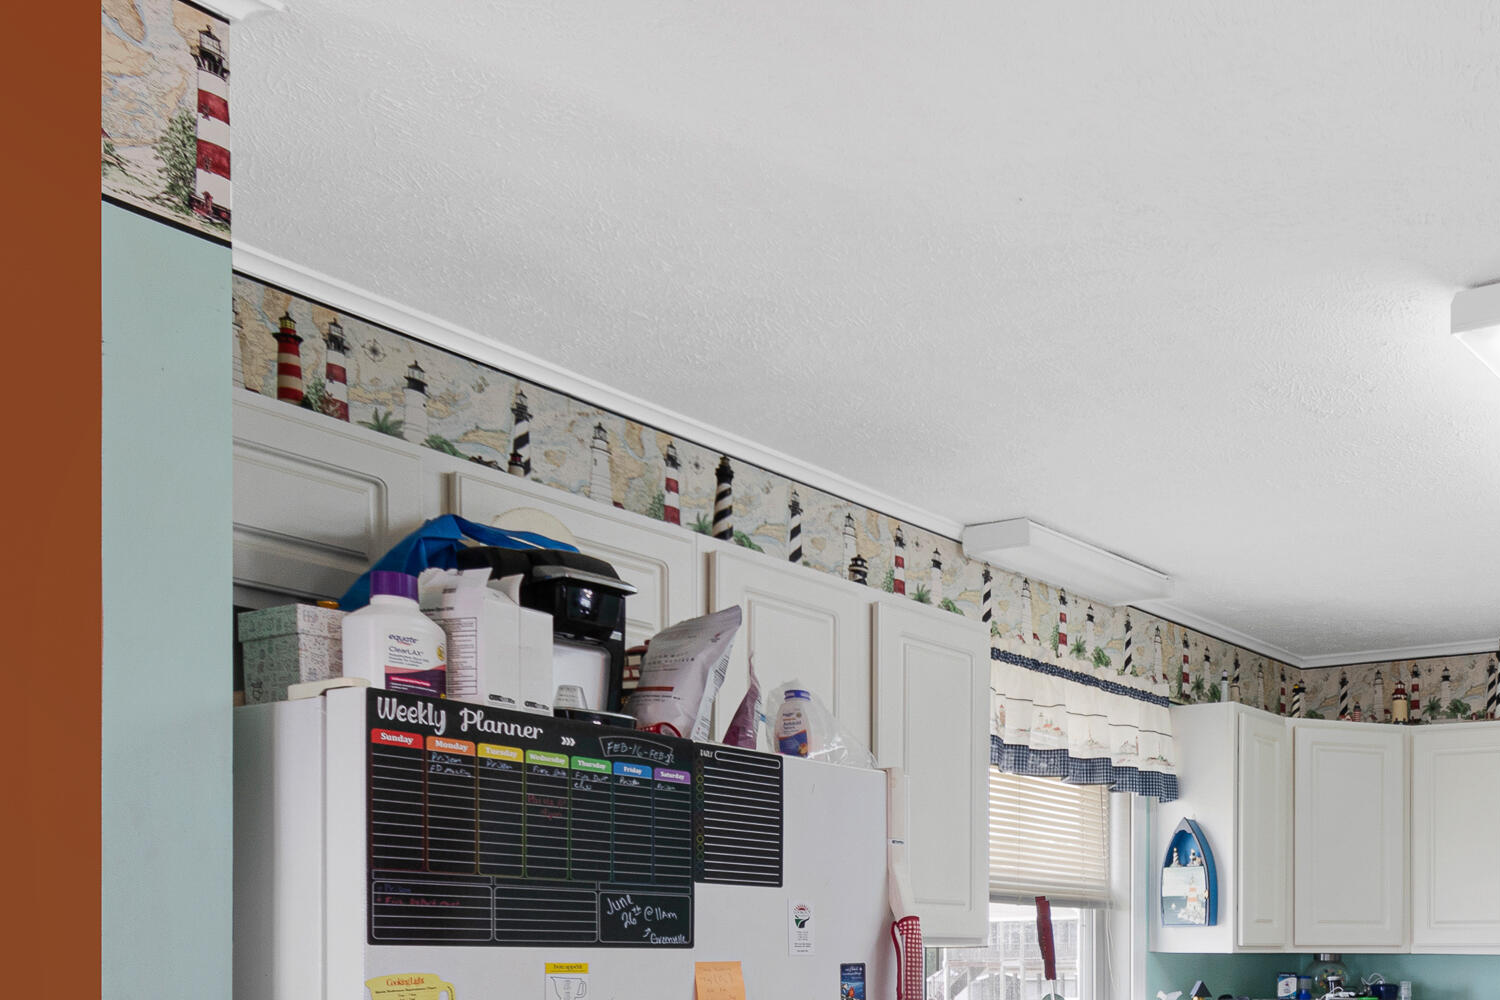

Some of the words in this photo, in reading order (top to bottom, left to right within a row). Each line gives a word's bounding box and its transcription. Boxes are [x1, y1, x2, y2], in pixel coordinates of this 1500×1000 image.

[376, 696, 446, 735] Weekly
[459, 707, 544, 740] Planner
[381, 732, 414, 745] Sunday
[435, 740, 469, 753] Monday
[486, 746, 518, 758] Tuesday
[529, 753, 566, 765] Wednesday
[577, 759, 607, 770] Thursday
[623, 765, 643, 775] Friday
[660, 771, 686, 780] Saturday
[606, 894, 634, 915] June
